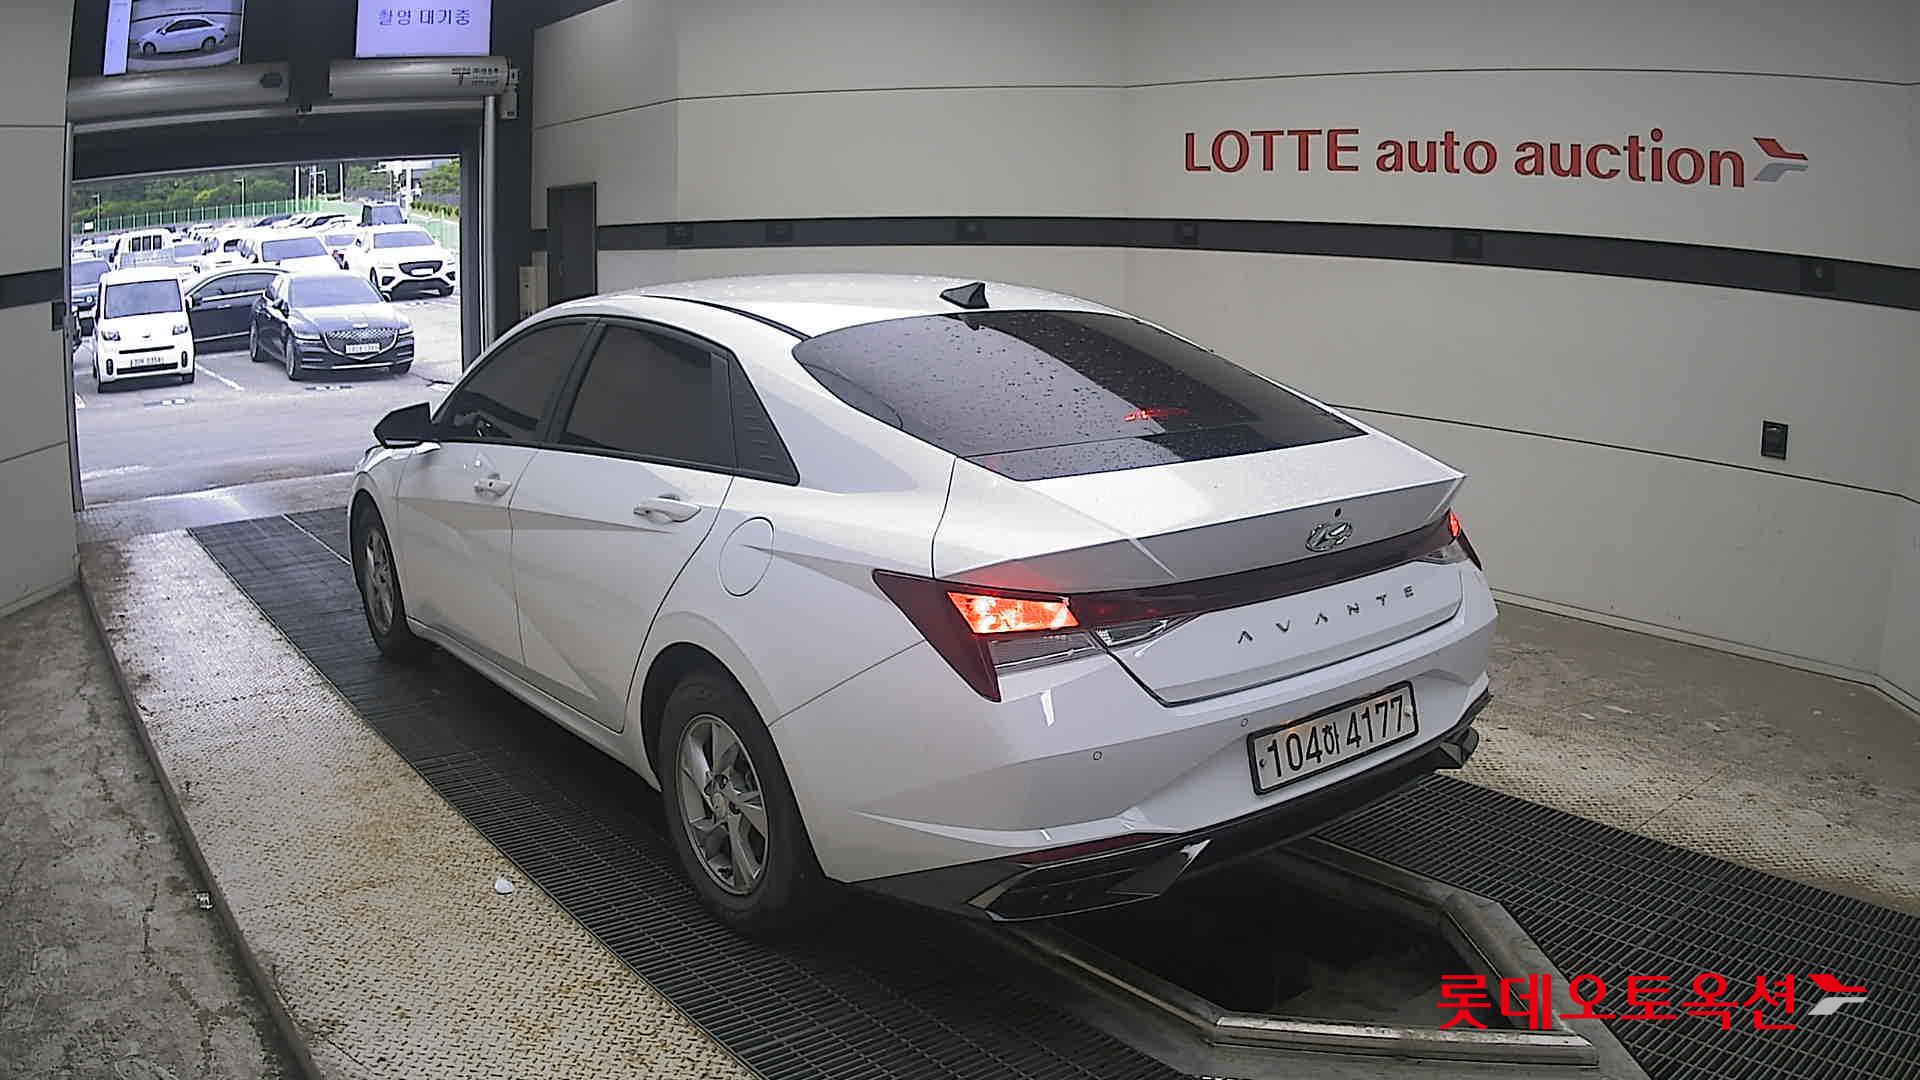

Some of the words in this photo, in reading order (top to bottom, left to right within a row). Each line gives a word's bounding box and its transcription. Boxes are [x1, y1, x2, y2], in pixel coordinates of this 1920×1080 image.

[420, 8, 472, 26] 대기중
[1184, 129, 1360, 173] LOTTE
[1376, 130, 1498, 174] auto
[1514, 129, 1746, 188] auction
[1237, 585, 1415, 645] AVANTE
[1266, 719, 1341, 778] 104하
[1346, 694, 1405, 749] 4177
